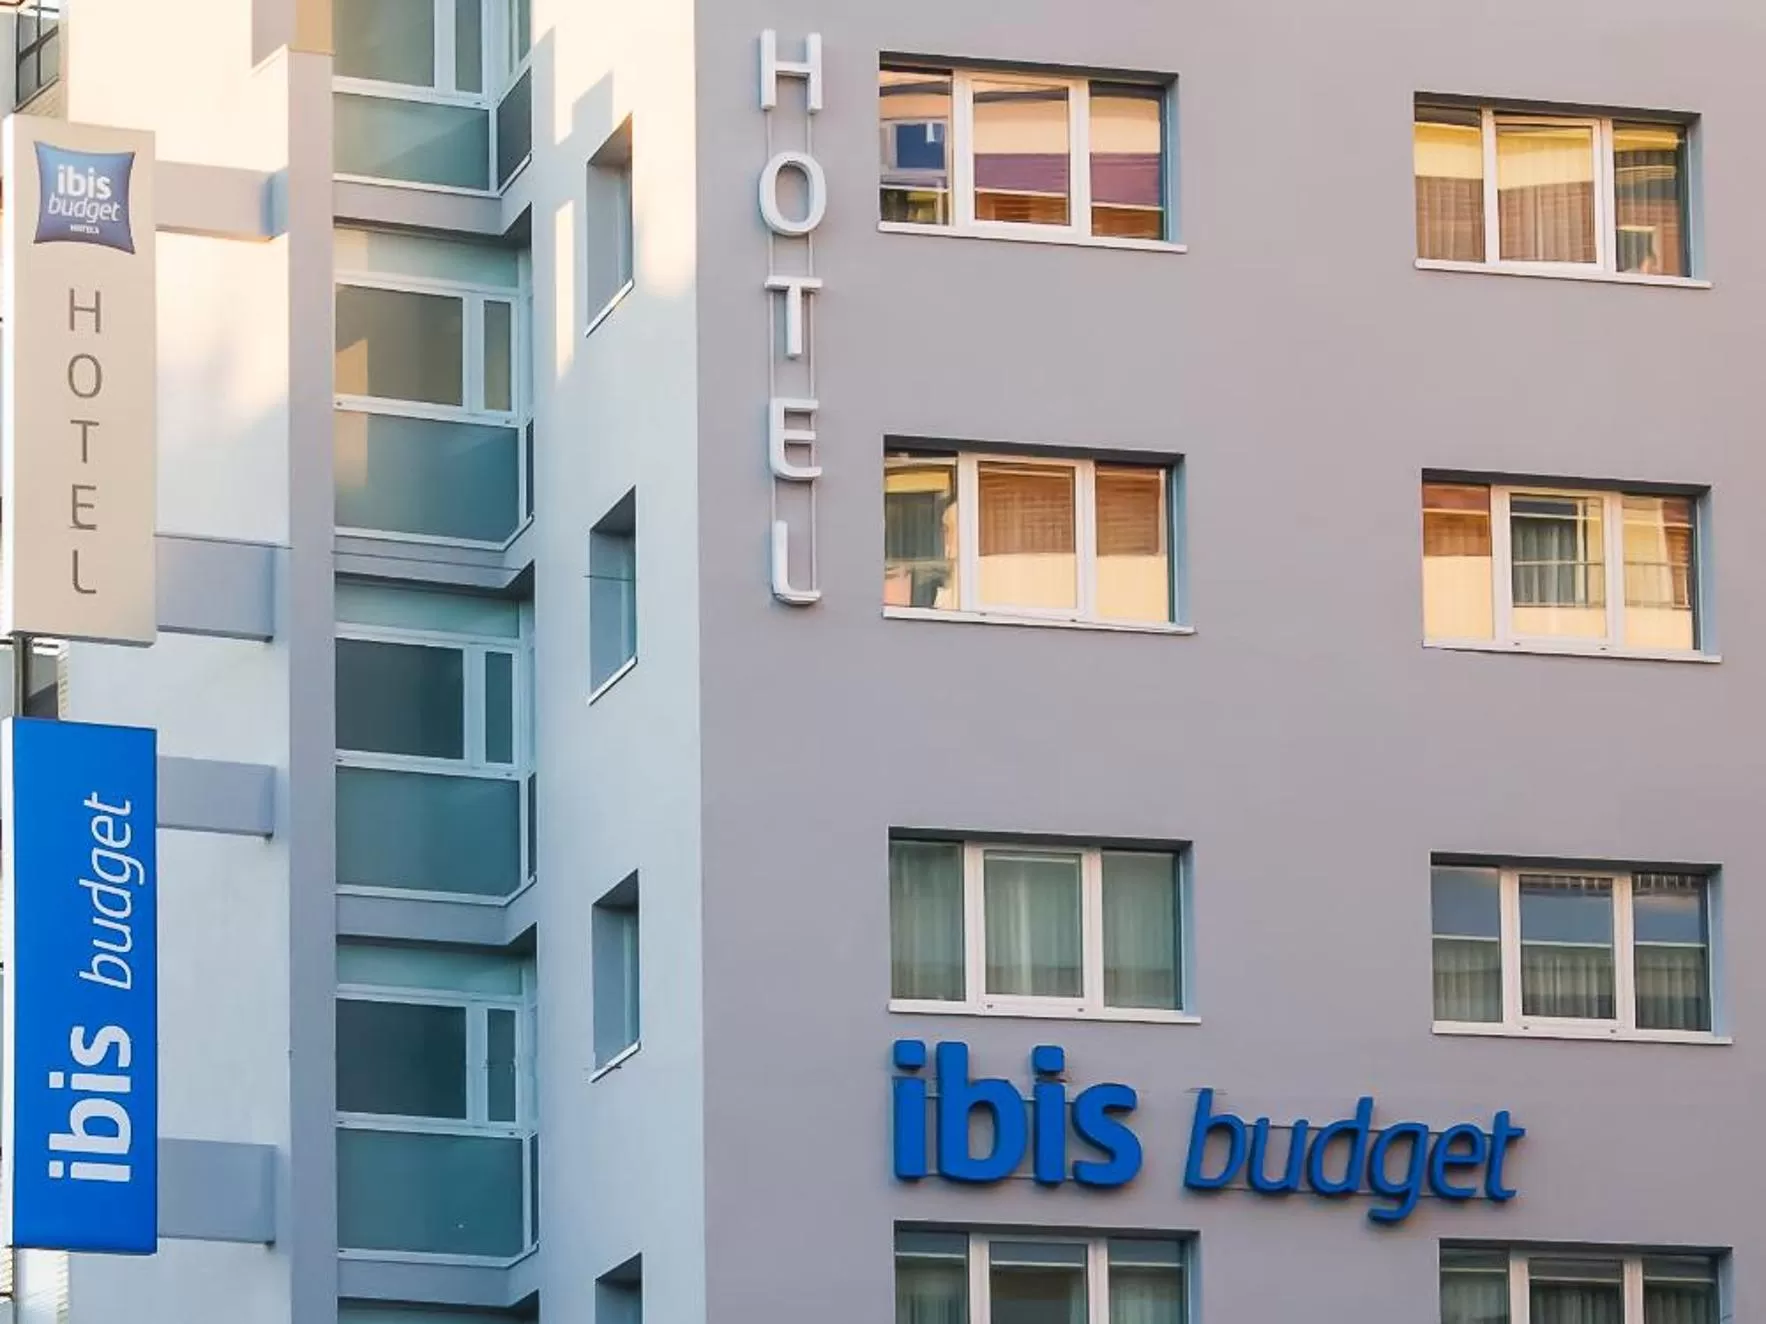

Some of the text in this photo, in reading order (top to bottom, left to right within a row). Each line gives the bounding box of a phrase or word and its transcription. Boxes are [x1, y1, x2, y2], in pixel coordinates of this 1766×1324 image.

[48, 191, 121, 224] budget
[57, 163, 112, 200] ibis
[67, 287, 102, 594] HOTEL
[758, 28, 827, 607] HOTEL
[48, 791, 146, 1183] ibis budget
[892, 1039, 1526, 1225] ibis budget
